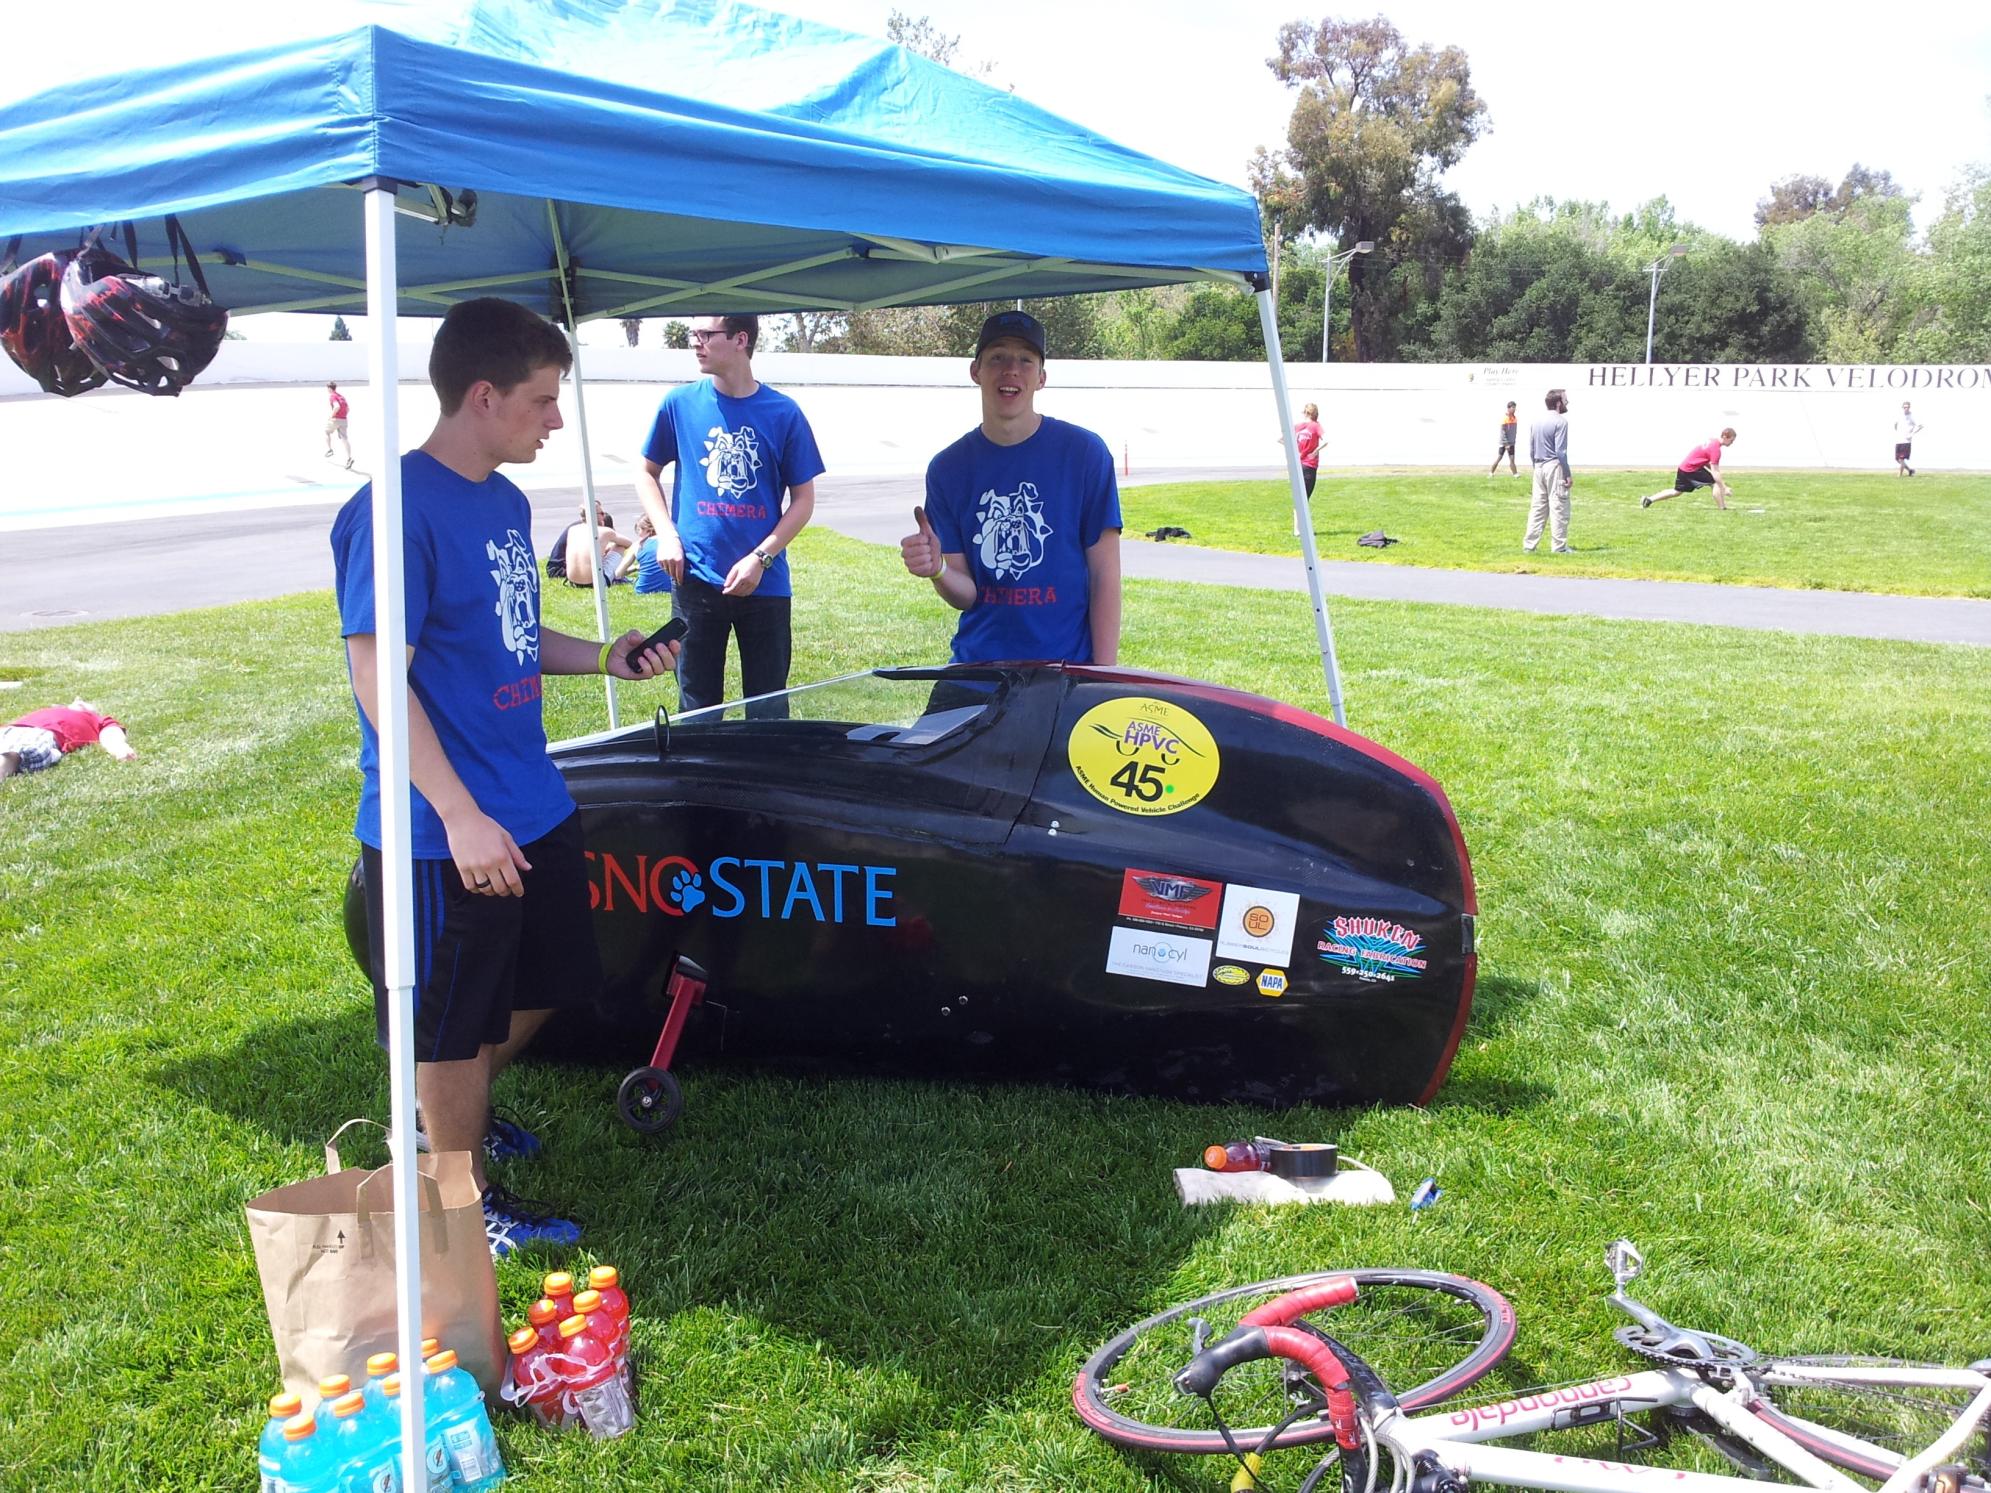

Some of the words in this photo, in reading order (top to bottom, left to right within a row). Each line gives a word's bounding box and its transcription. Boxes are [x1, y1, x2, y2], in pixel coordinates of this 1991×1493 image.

[1588, 366, 1721, 387] HELLYER
[1733, 366, 1811, 388] PARK
[1124, 730, 1180, 755] HPVC
[1127, 721, 1161, 736] ASME
[1075, 765, 1090, 785] ASME
[1088, 783, 1110, 802] Human
[1110, 798, 1140, 813] Powered
[1141, 806, 1166, 814] Vehicle
[1167, 792, 1200, 811] Challenge
[1109, 760, 1166, 803] 45
[708, 856, 897, 927] STATE
[1260, 975, 1283, 990] NAPA
[1451, 1377, 1632, 1432] cannondale
